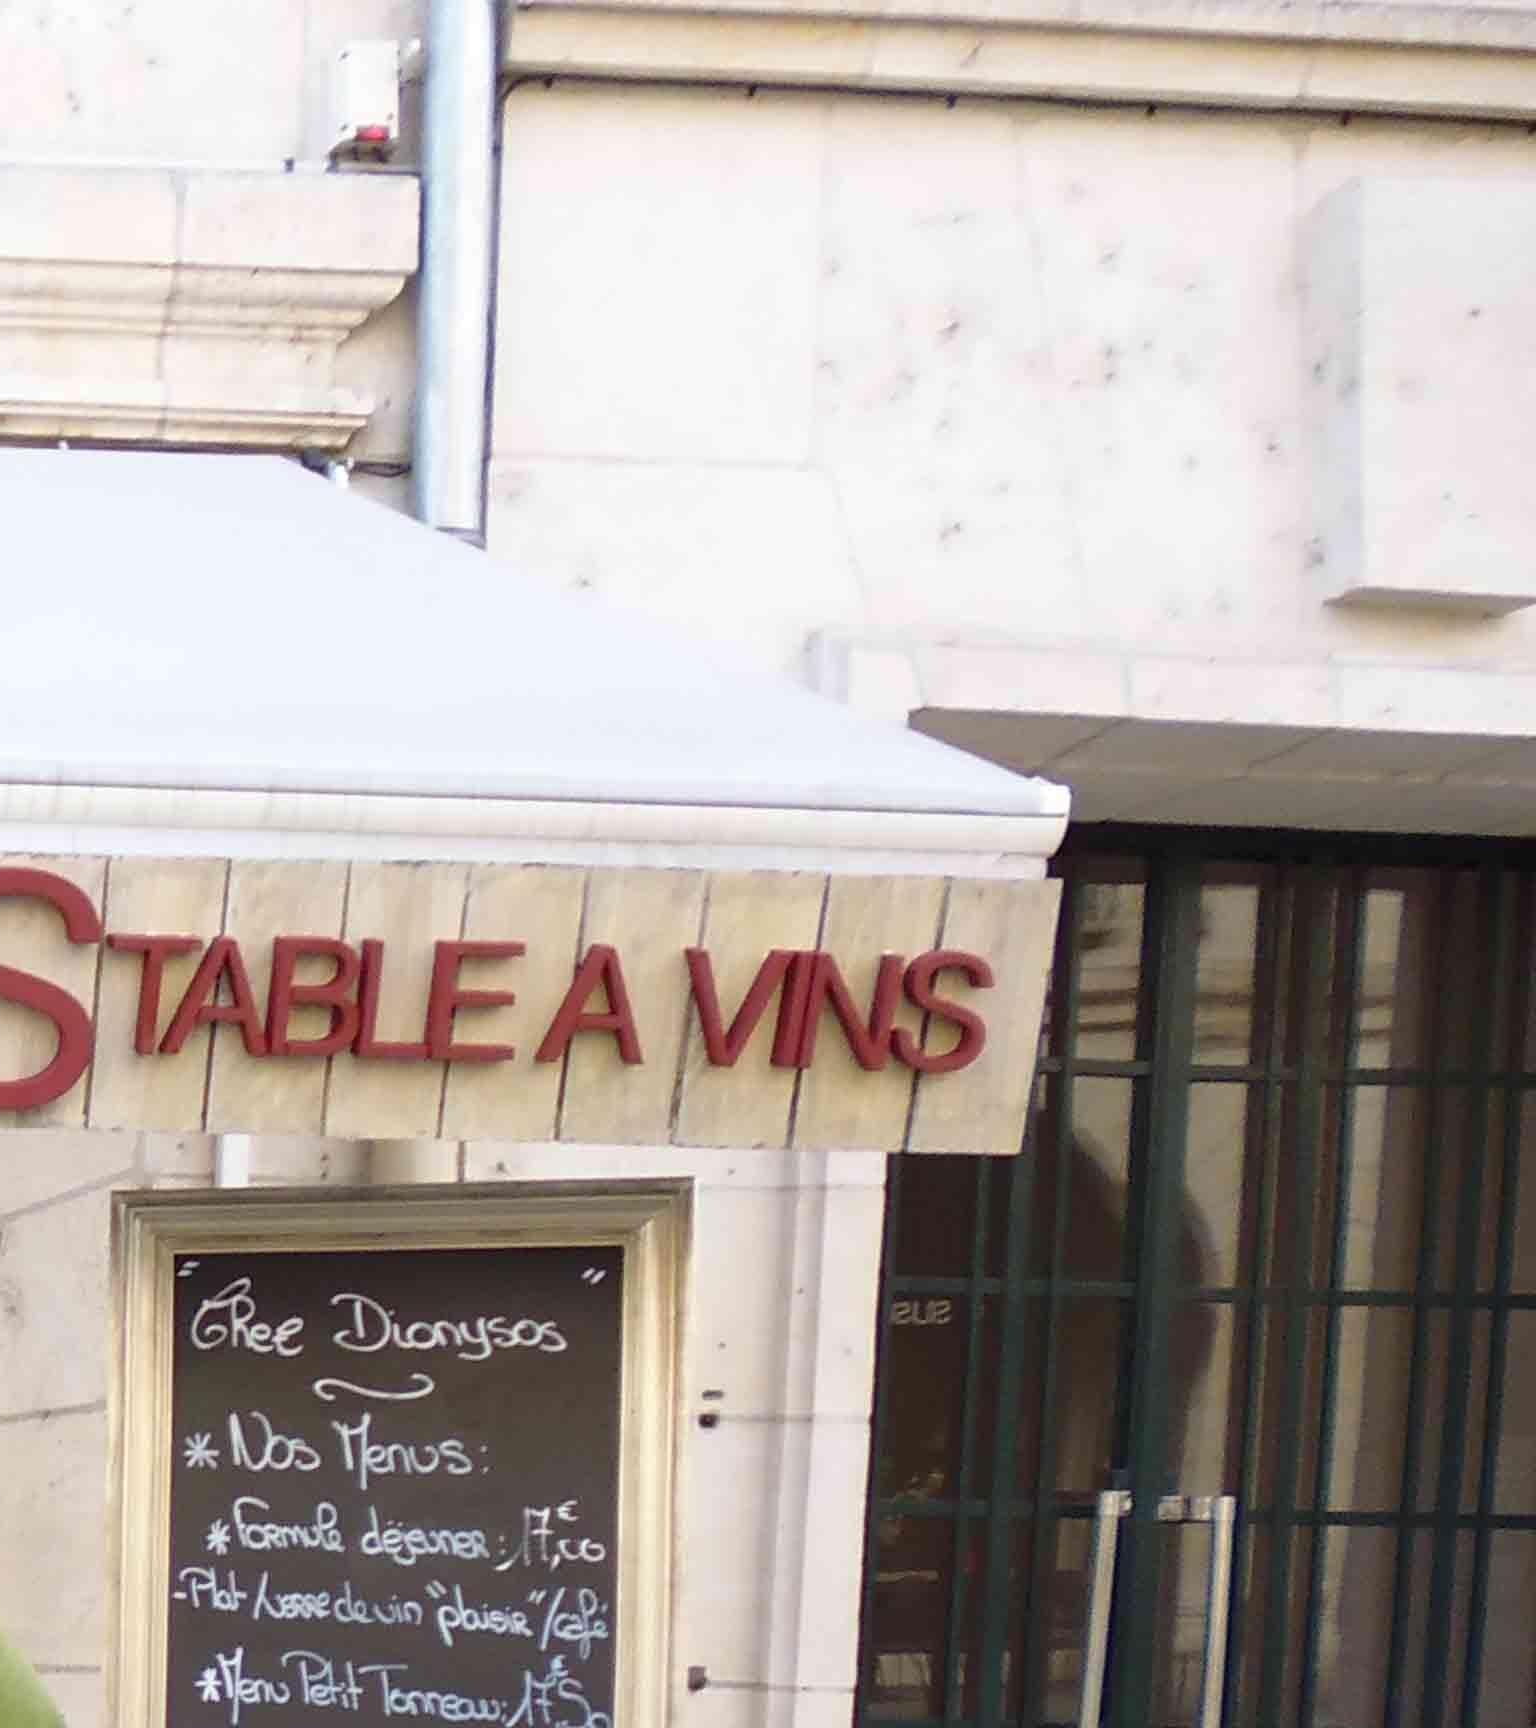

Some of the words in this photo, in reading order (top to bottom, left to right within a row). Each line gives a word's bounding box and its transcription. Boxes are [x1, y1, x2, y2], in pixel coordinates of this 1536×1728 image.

[106, 933, 527, 1064] TABLE
[534, 943, 644, 1067] A
[686, 945, 997, 1075] VINS
[330, 1292, 569, 1361] Dionysos
[229, 1410, 322, 1471] Nos
[233, 1496, 345, 1553] Formule
[215, 1646, 291, 1725] Menu
[280, 1650, 363, 1710] Petit
